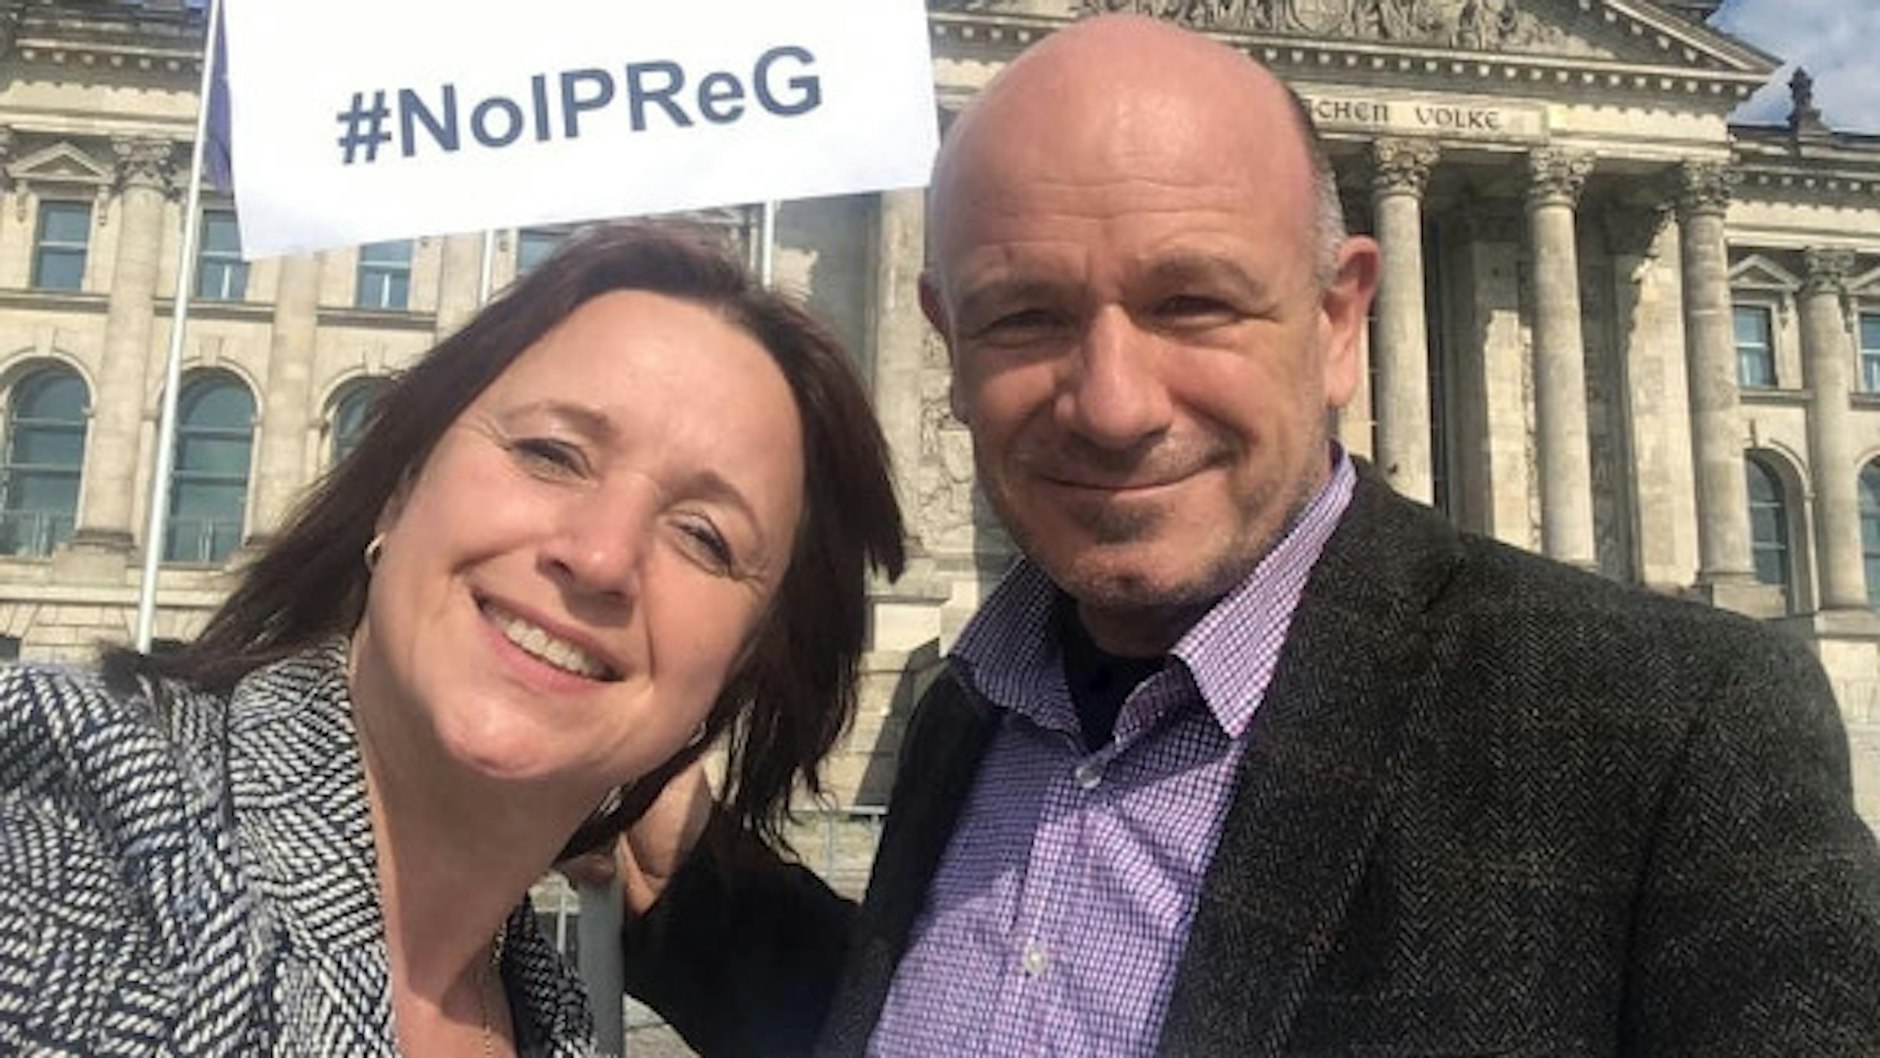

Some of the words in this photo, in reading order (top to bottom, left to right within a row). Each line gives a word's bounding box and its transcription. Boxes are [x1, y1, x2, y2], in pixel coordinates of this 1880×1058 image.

[336, 45, 823, 164] #NoIPReG
[1303, 100, 1389, 122] CHEN
[1415, 107, 1501, 130] VOLKE
